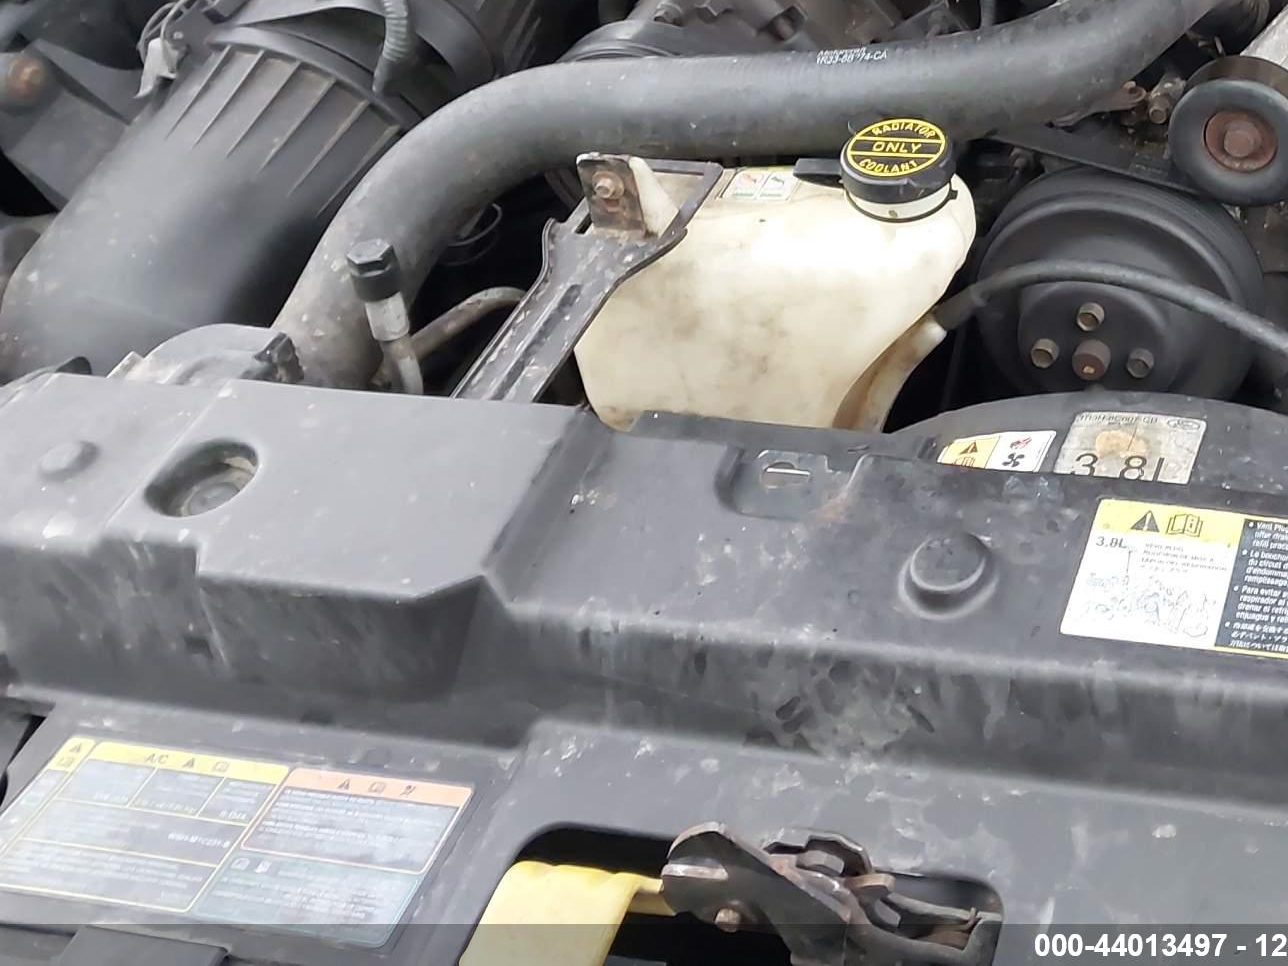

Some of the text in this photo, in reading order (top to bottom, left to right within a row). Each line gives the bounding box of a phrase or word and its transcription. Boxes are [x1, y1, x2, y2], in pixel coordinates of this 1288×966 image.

[871, 121, 936, 139] RADIATOR
[872, 141, 922, 154] ONLY
[858, 158, 918, 174] COOLANT
[1095, 535, 1128, 549] 3.8L
